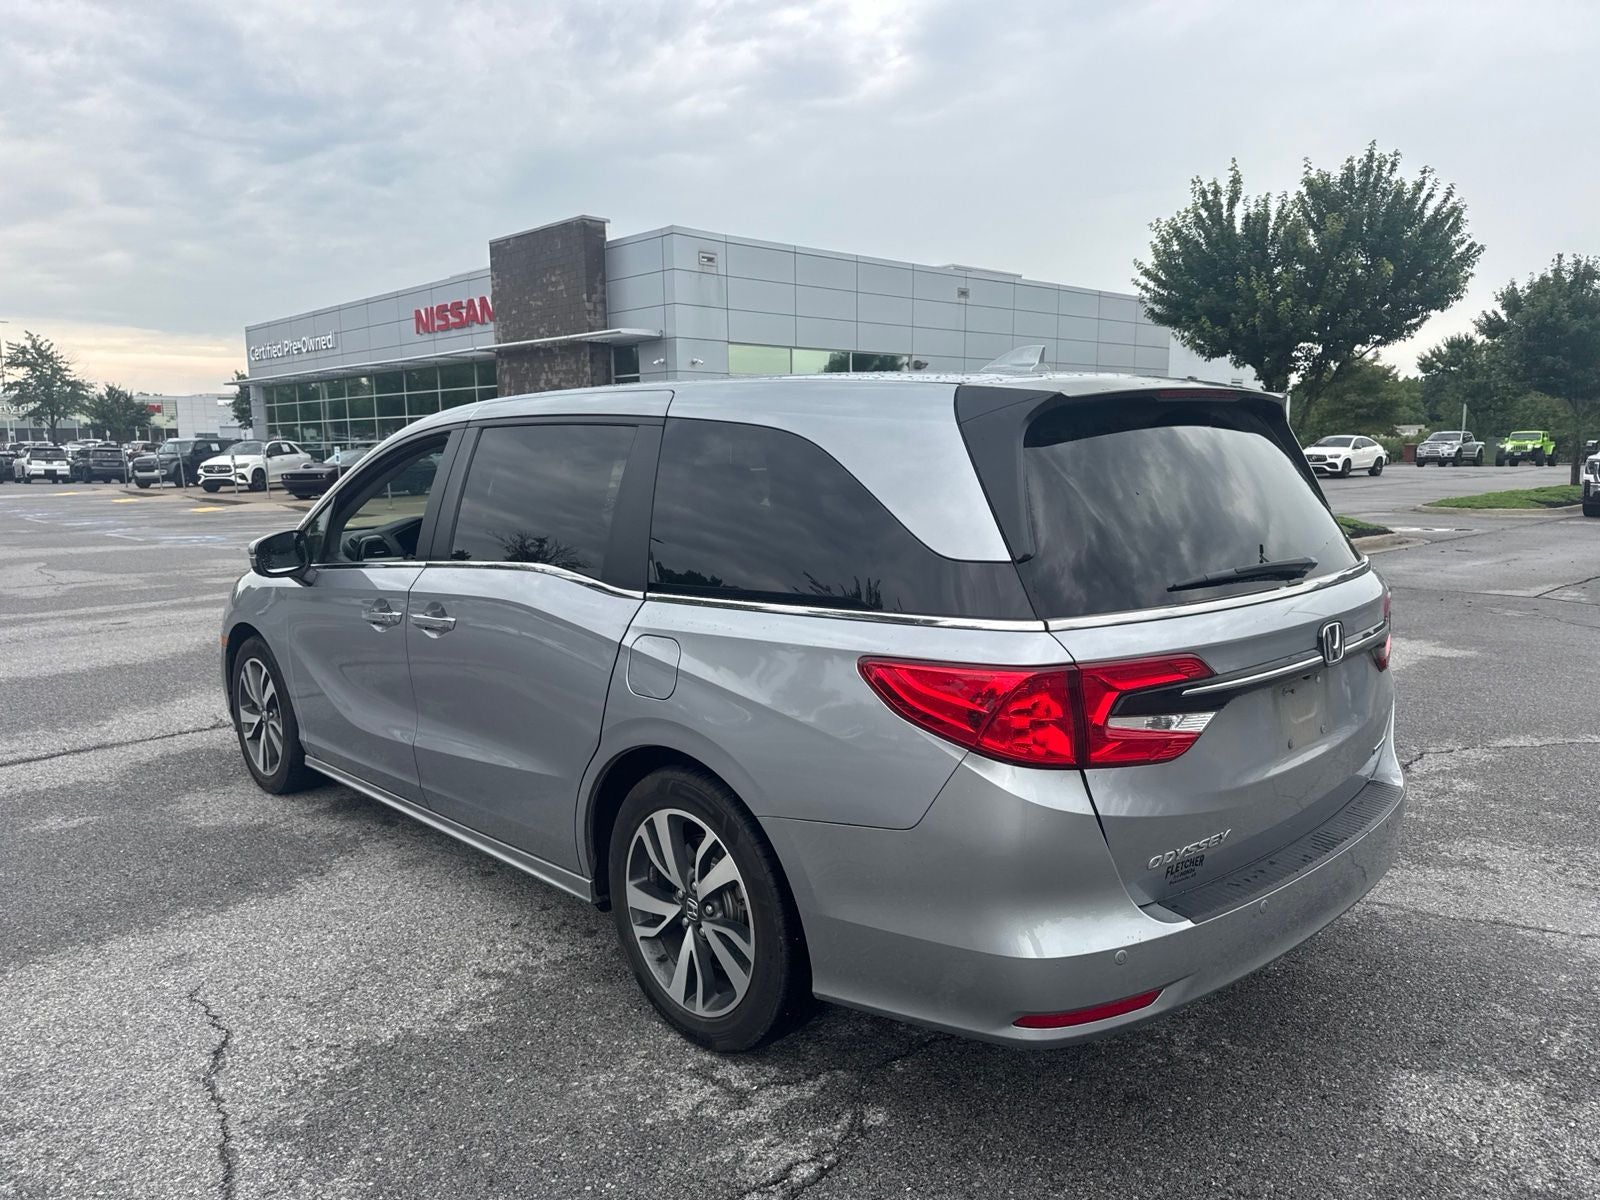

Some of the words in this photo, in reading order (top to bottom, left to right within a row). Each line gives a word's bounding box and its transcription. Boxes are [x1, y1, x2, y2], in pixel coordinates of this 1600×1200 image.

[414, 296, 494, 335] NISSAN
[249, 341, 283, 361] Certified
[283, 331, 335, 356] Pre-Owned
[1147, 828, 1232, 870] ODYSSEY
[1164, 854, 1205, 880] FLETCHER
